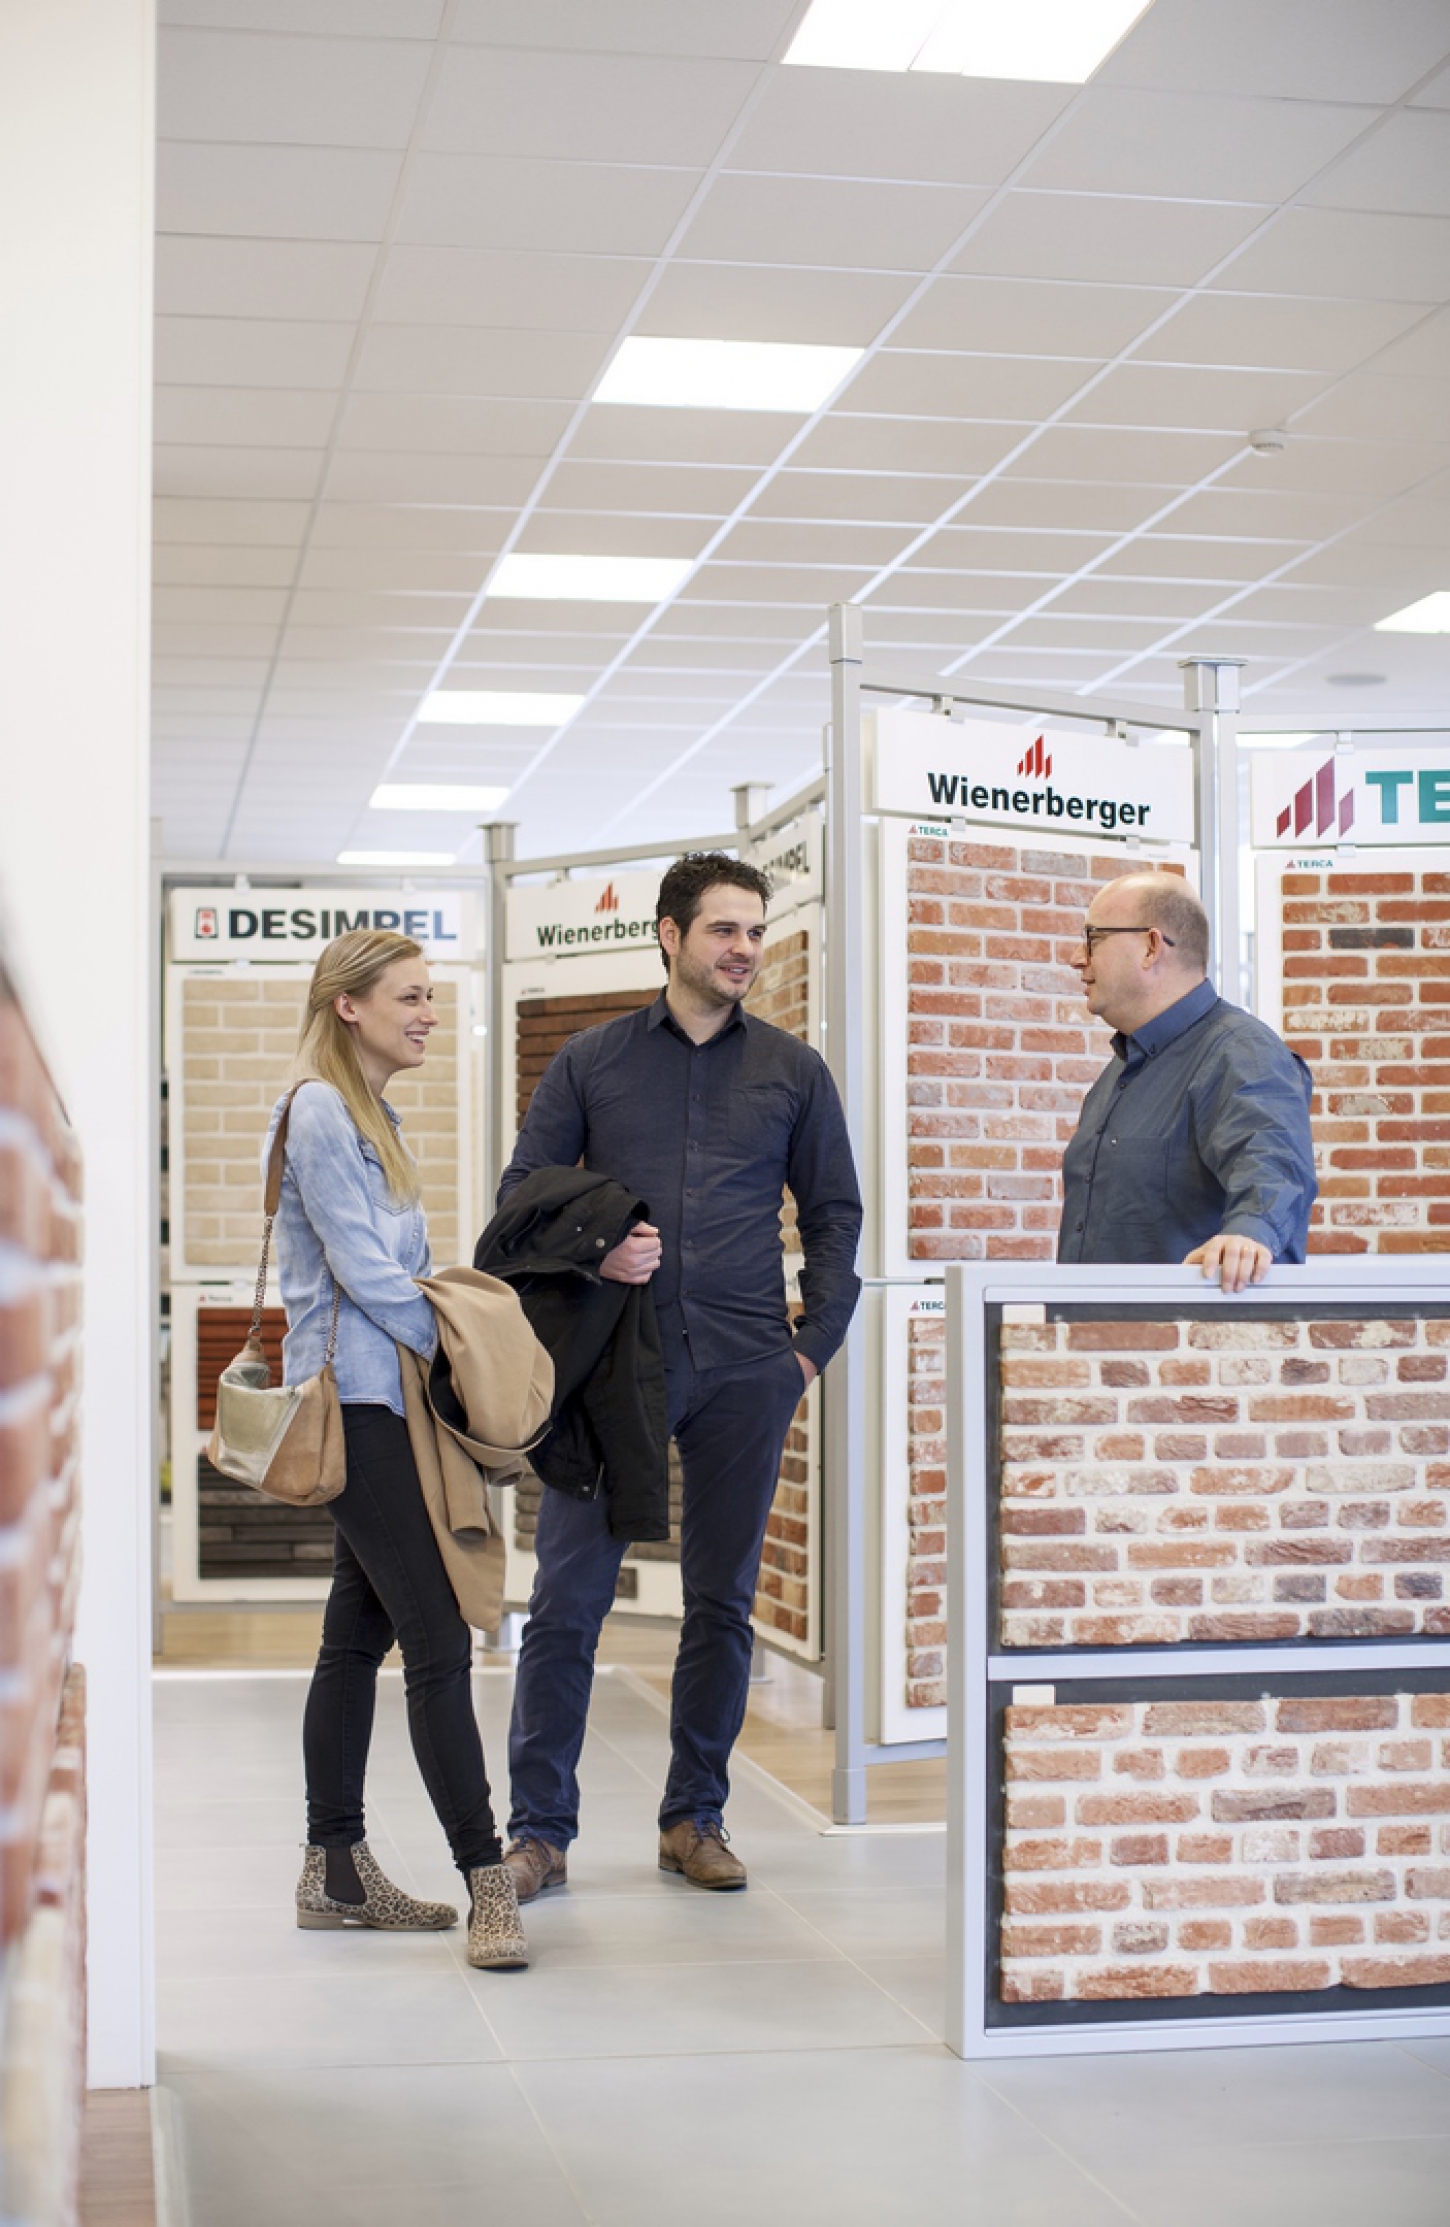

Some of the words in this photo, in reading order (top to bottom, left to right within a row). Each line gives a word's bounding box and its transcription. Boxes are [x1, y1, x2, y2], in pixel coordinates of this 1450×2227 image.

[927, 772, 1151, 829] Wienerberger
[1297, 859, 1334, 868] TERCA
[228, 909, 457, 940] DESIMPEL
